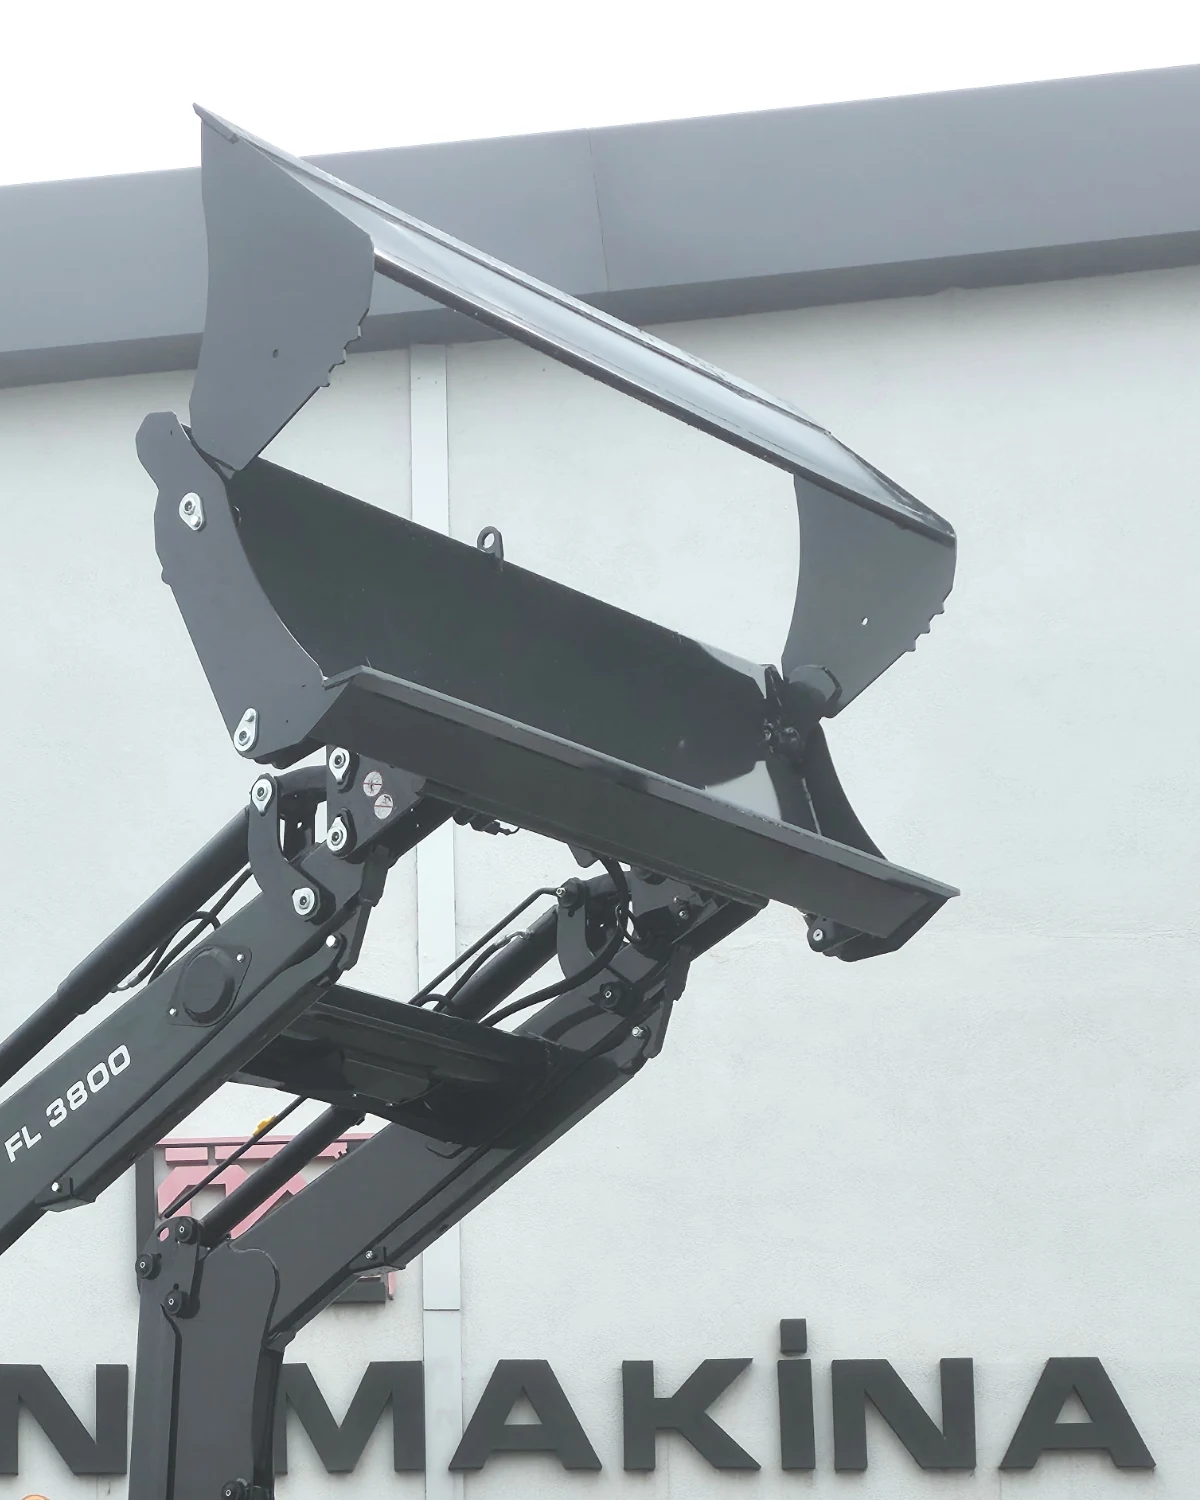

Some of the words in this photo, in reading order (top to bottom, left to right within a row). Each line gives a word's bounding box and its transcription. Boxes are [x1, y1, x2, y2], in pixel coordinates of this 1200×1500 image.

[4, 1125, 42, 1163] FL
[46, 1044, 131, 1128] 3800
[274, 1318, 1156, 1475] MAKİNA
